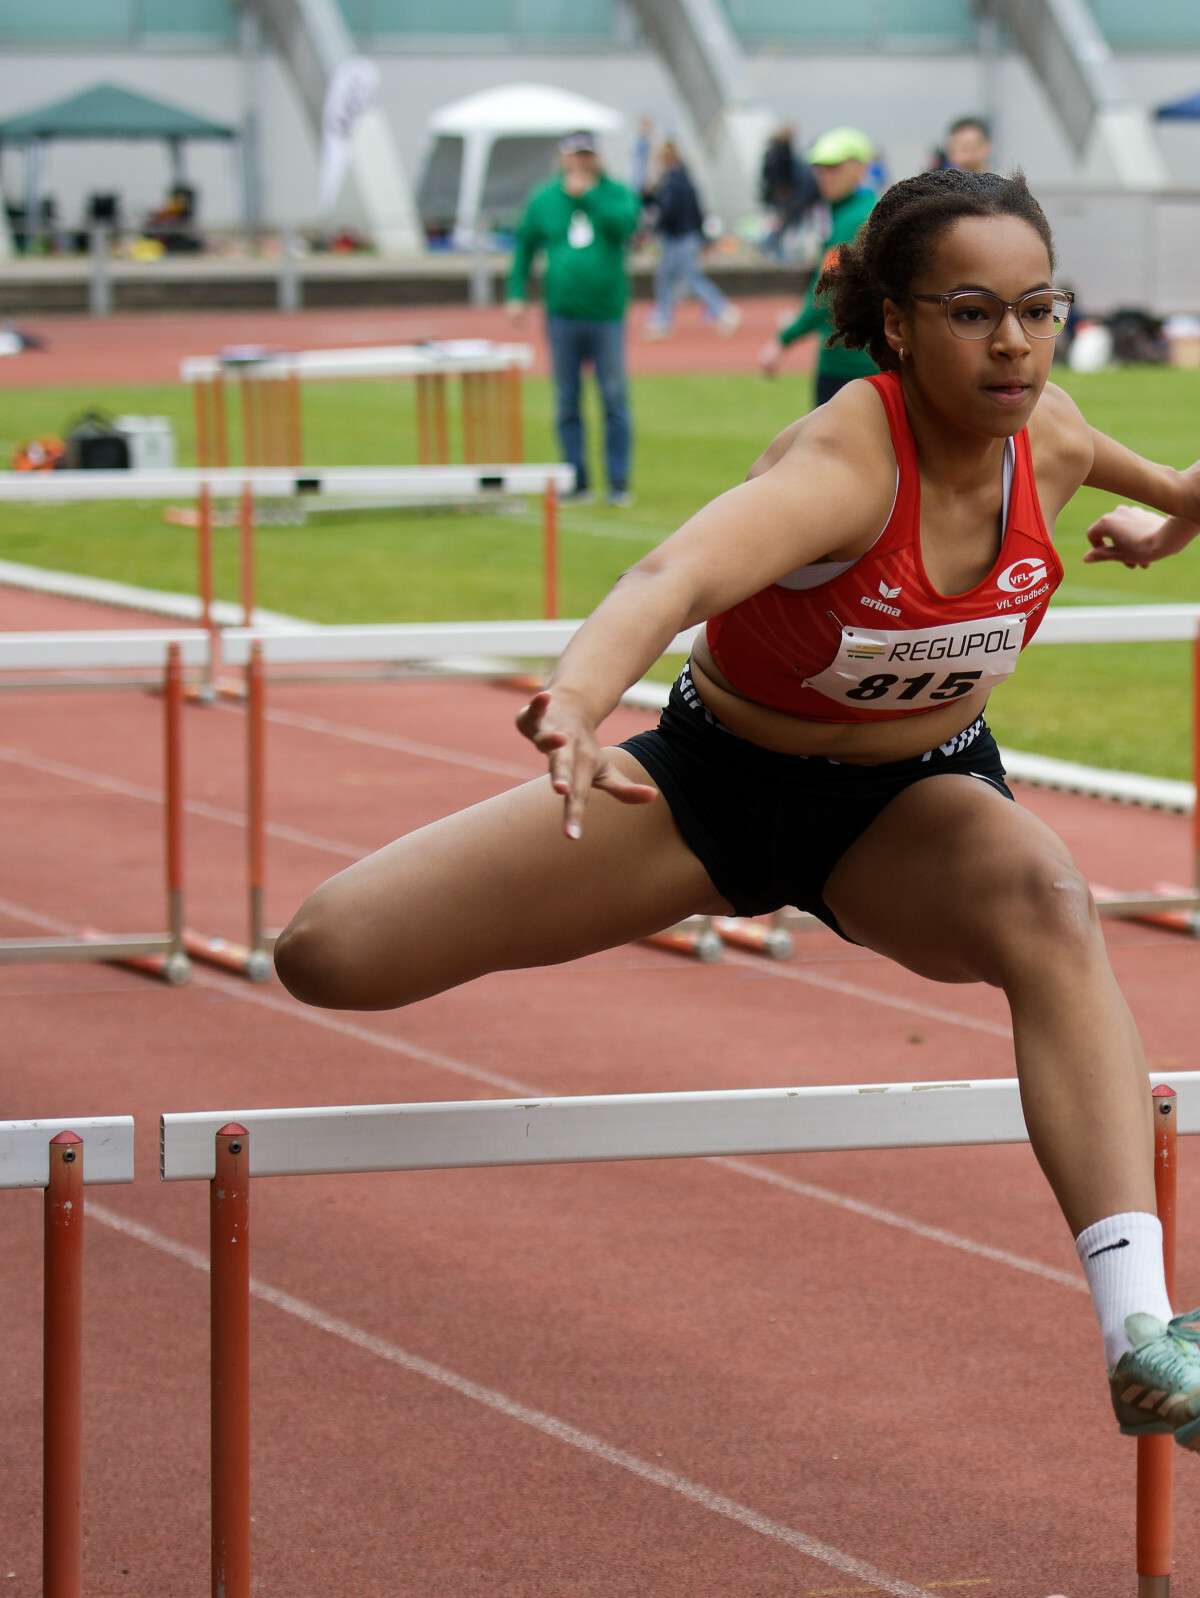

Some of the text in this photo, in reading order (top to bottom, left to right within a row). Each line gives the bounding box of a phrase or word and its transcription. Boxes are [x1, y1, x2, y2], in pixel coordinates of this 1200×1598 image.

[860, 596, 902, 618] erima
[996, 583, 1050, 610] VfL Gladbeck
[888, 629, 1016, 662] REGUPOL
[846, 670, 983, 700] 815
